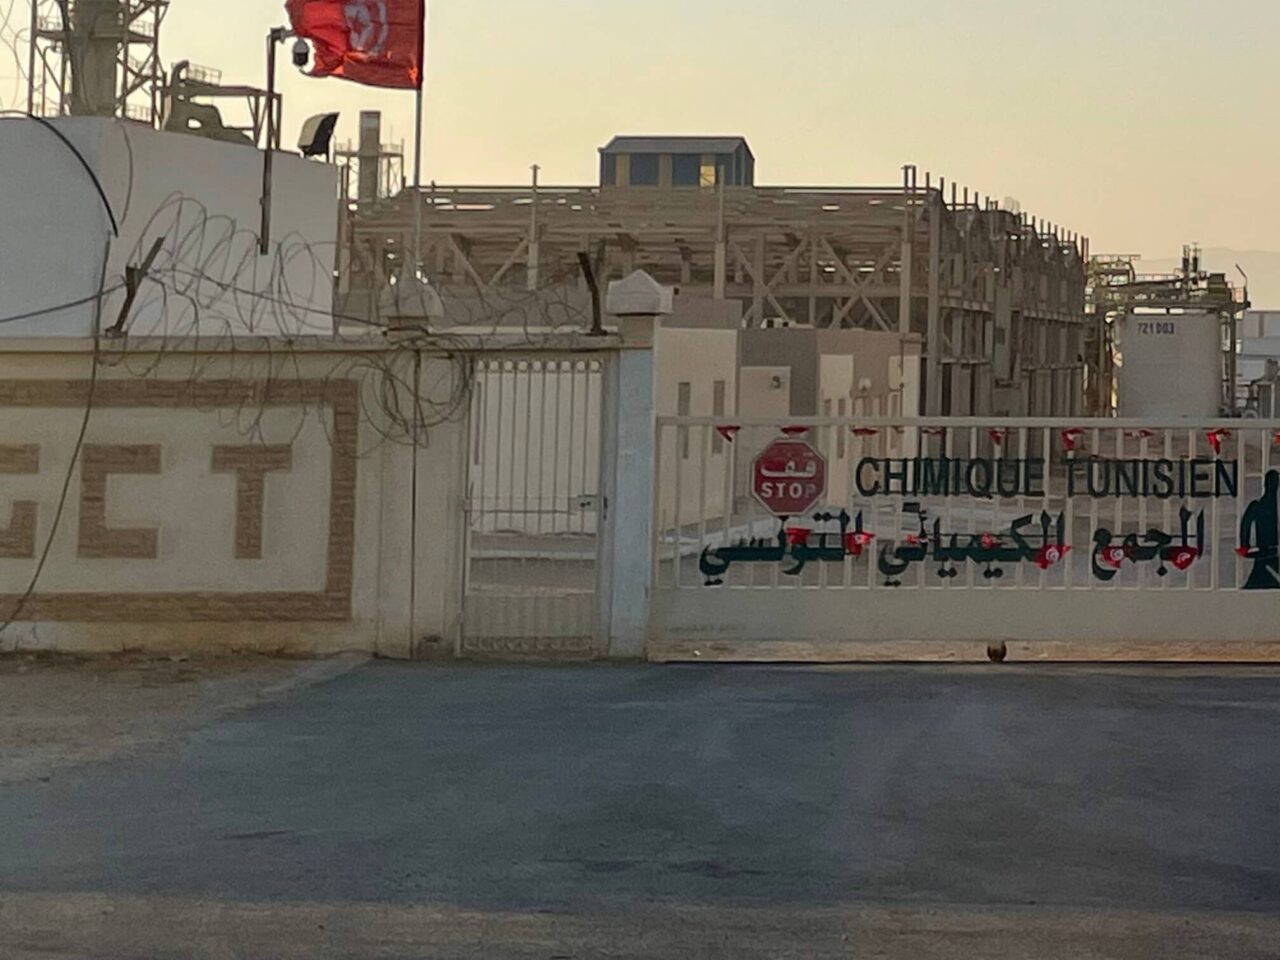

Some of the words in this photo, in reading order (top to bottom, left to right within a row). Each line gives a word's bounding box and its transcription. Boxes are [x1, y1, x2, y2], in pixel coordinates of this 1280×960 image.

[760, 451, 817, 478] قف
[855, 457, 1046, 499] CHIMIQUE
[1061, 456, 1238, 498] TUNISIEN
[761, 482, 817, 499] STOP
[1092, 505, 1204, 581] الجمع
